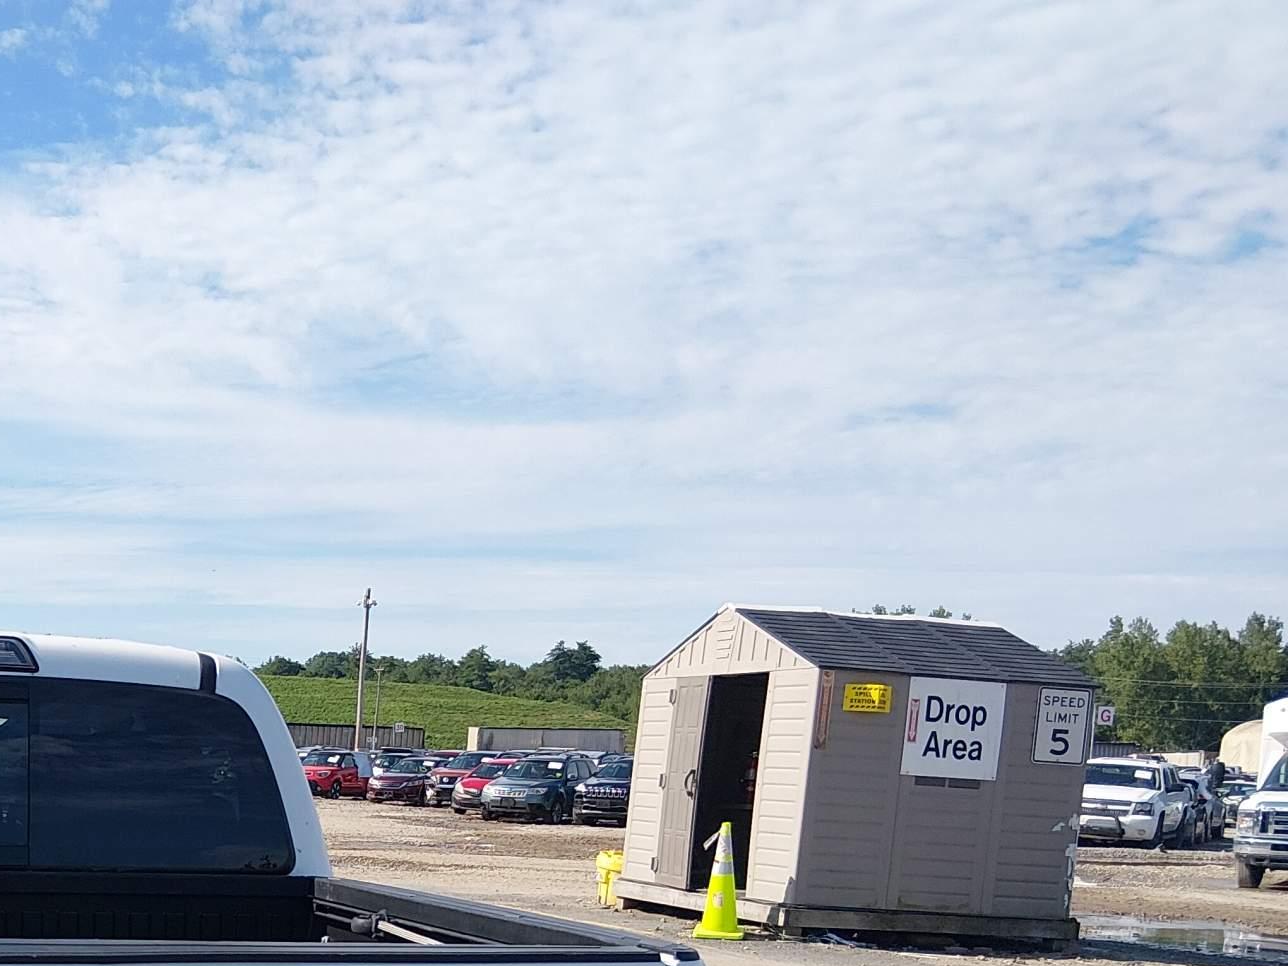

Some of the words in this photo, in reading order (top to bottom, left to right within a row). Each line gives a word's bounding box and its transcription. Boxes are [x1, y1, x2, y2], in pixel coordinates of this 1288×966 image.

[1043, 695, 1086, 708] SPEED
[925, 695, 987, 731] Drop
[1045, 711, 1079, 724] LIMIT
[1100, 709, 1112, 722] G
[922, 731, 983, 761] Area
[1049, 728, 1069, 756] 5
